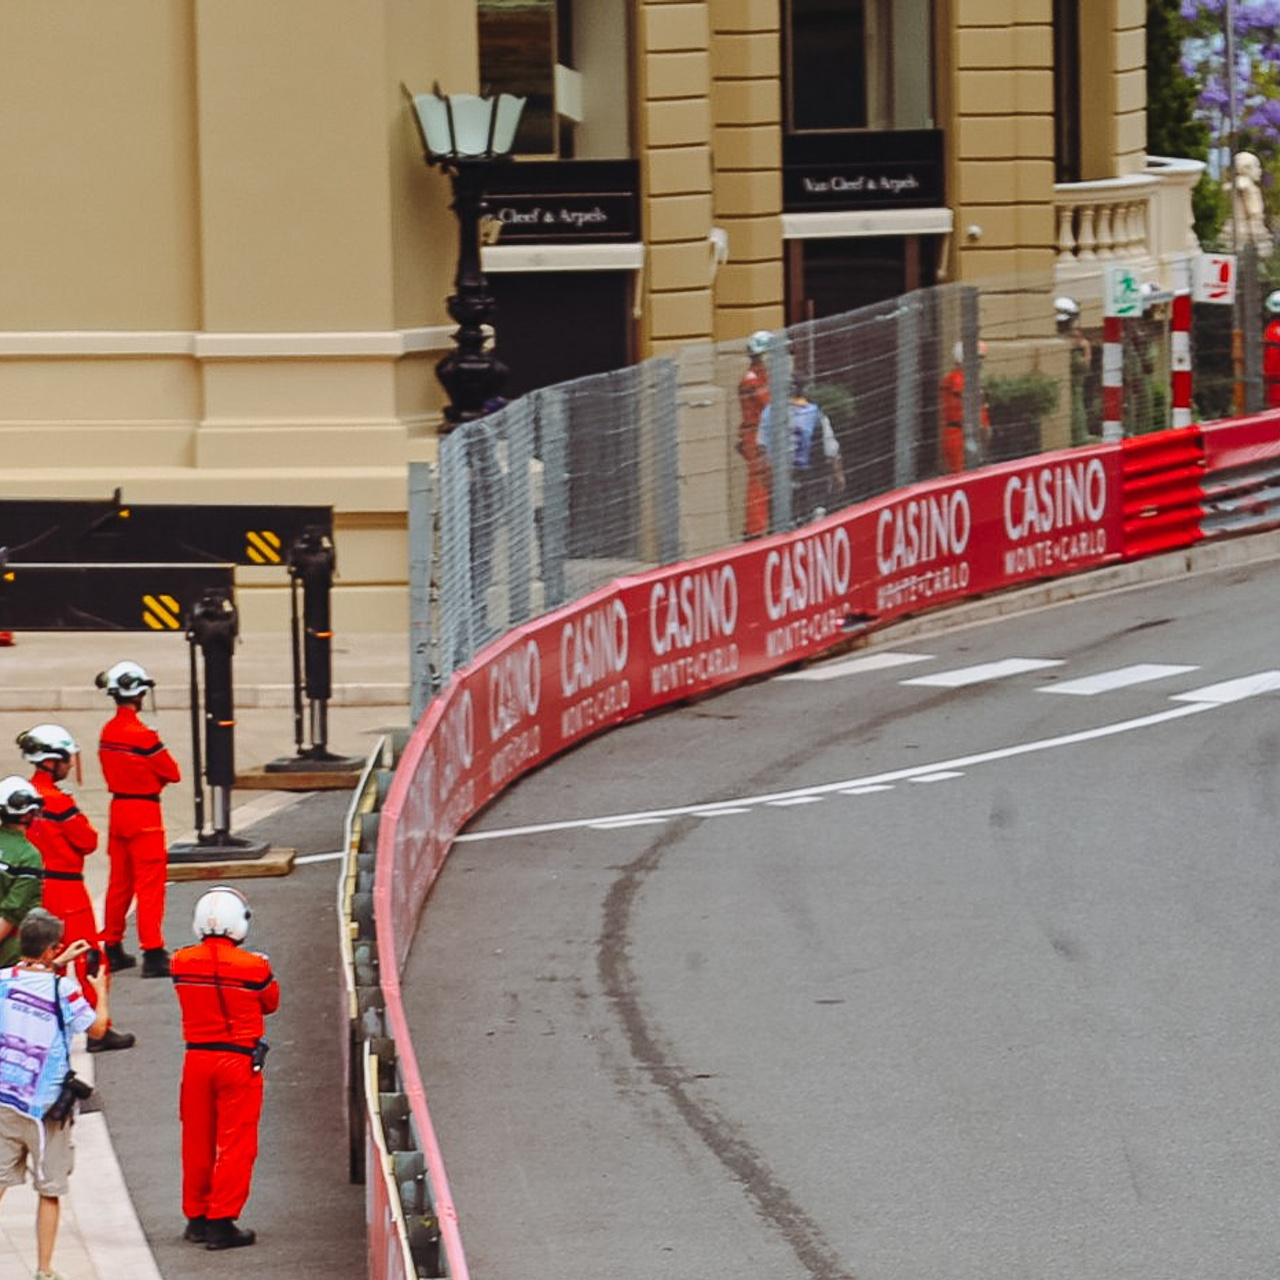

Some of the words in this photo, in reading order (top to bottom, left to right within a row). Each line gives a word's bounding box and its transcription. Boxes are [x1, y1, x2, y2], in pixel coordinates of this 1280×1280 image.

[500, 207, 541, 224] Cleef
[559, 209, 607, 227] Arpels
[831, 175, 864, 190] Cleef
[879, 177, 919, 192] Arpels
[876, 489, 970, 576] CASINO
[1004, 458, 1106, 541] CASINO
[764, 526, 851, 621] CASINO
[1060, 528, 1106, 560] CARLO
[560, 599, 629, 697] CASINO
[650, 564, 738, 656] CASINO
